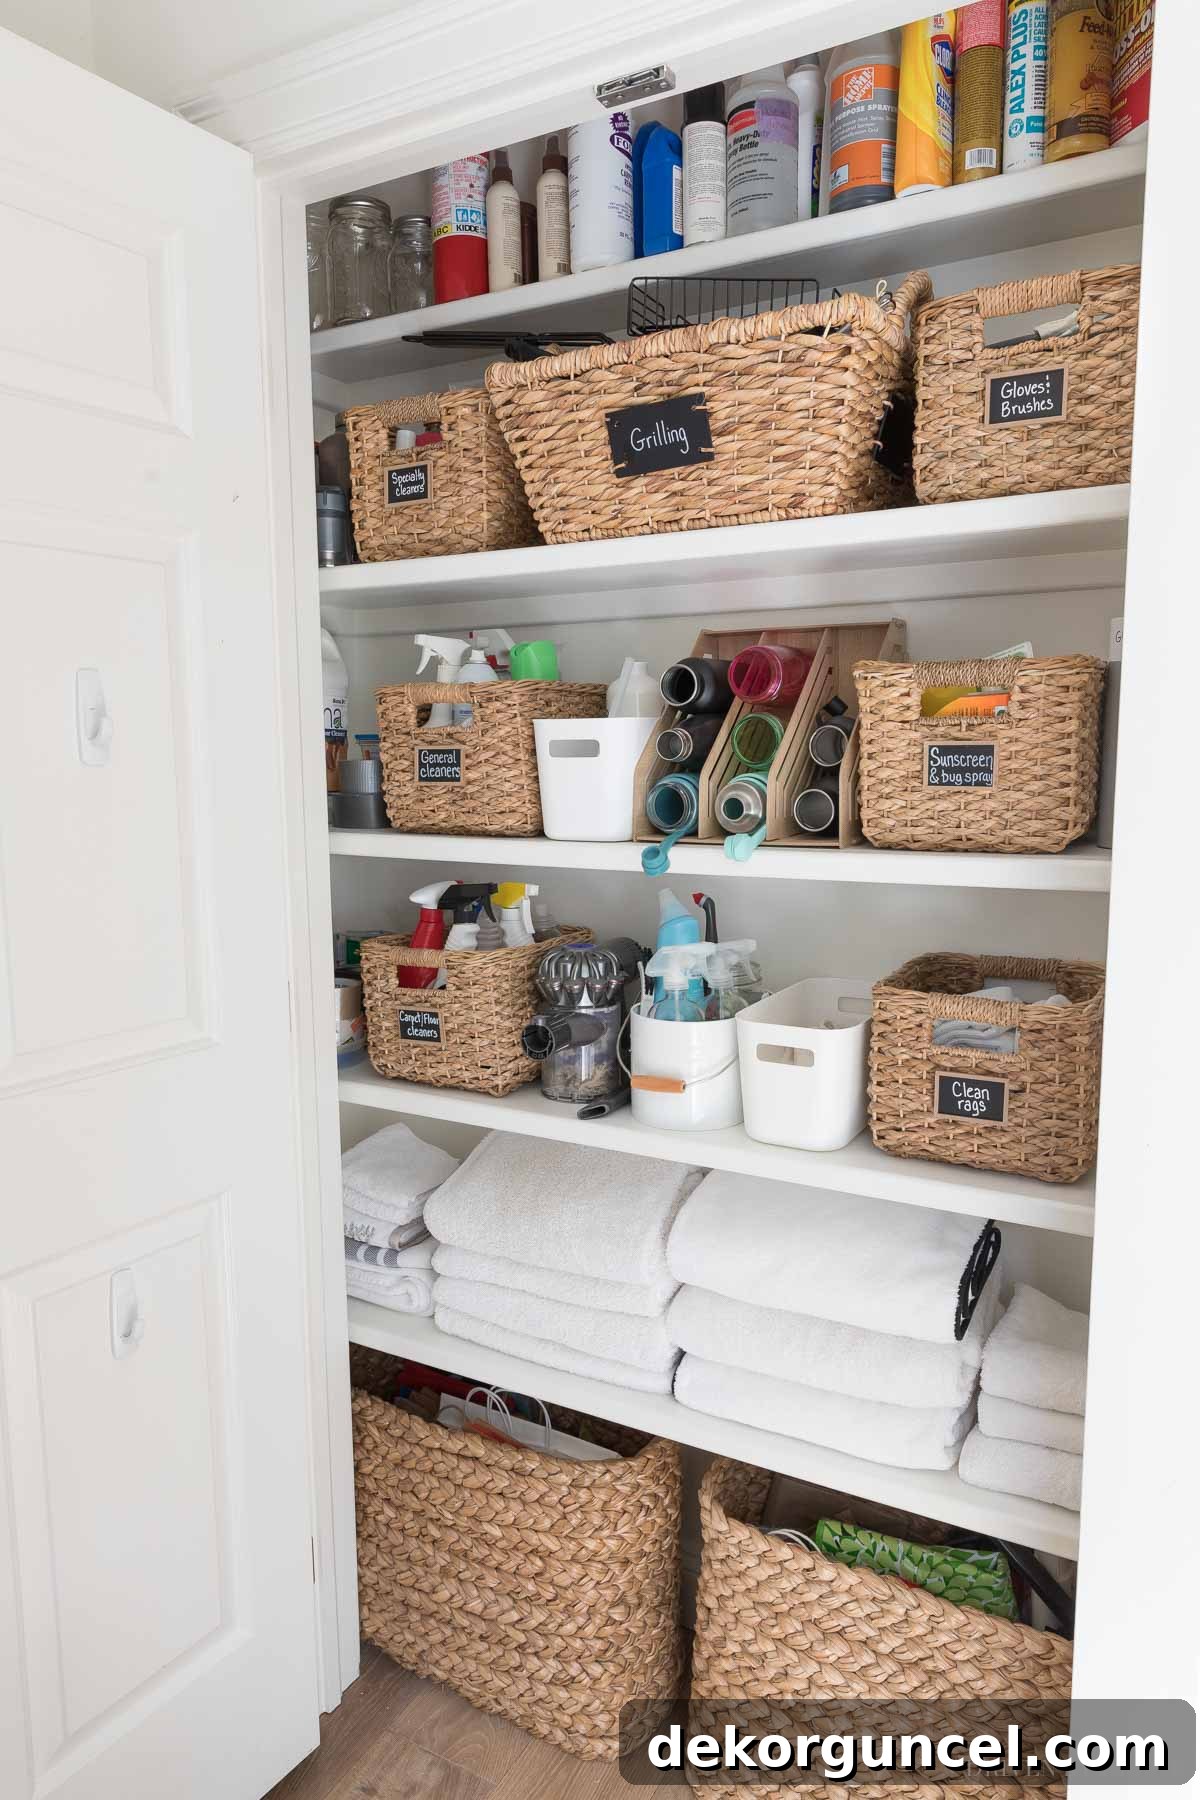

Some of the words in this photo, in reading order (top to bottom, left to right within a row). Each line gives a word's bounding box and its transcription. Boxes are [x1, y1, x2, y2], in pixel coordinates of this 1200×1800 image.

[1011, 9, 1029, 63] PLUS
[1009, 63, 1026, 114] ALEX
[456, 224, 480, 233] KIDDE
[1001, 397, 1054, 418] Brushes
[630, 419, 690, 455] Grilling
[391, 468, 426, 487] Specialty
[395, 484, 425, 497] cleaners
[421, 750, 457, 764] General
[930, 746, 993, 770] Sunscreen
[420, 763, 461, 778] cleaners
[929, 767, 940, 784] &
[941, 769, 962, 786] bug
[964, 771, 993, 786] spray
[407, 1025, 438, 1038] cleaners
[952, 1081, 990, 1101] Clean
[957, 1099, 987, 1117] rags
